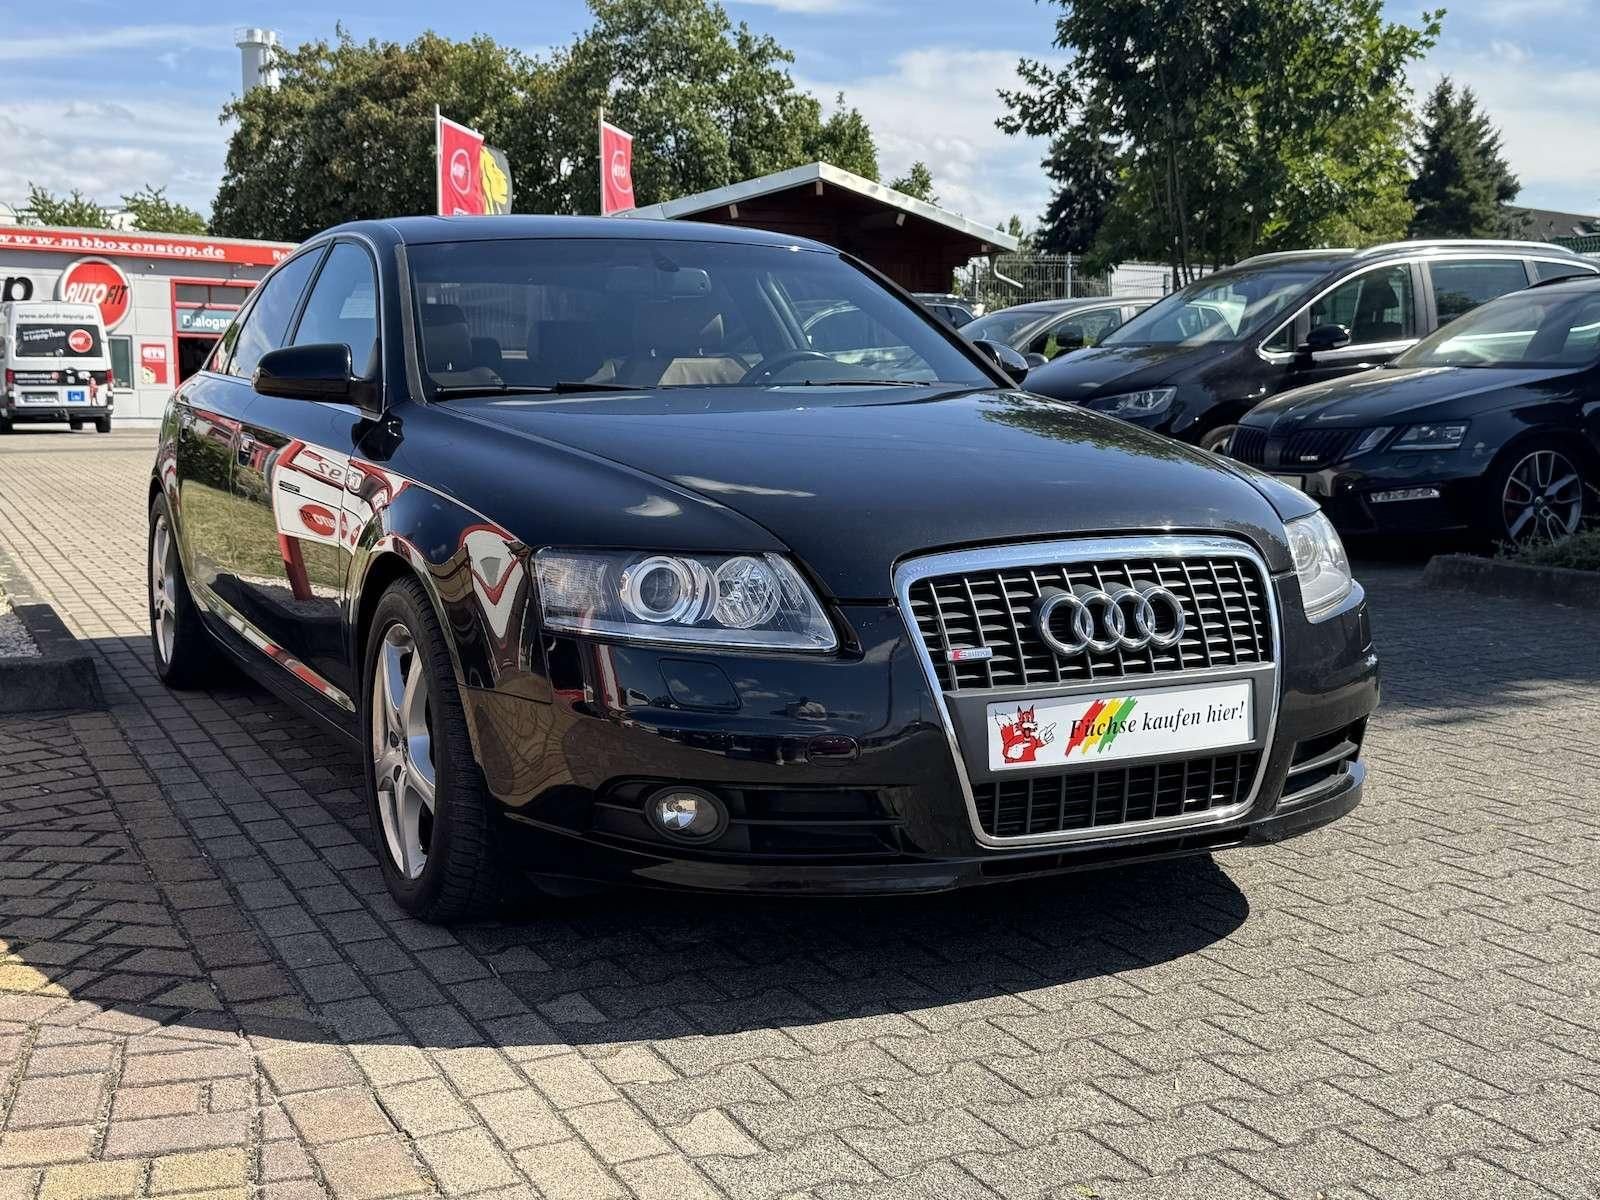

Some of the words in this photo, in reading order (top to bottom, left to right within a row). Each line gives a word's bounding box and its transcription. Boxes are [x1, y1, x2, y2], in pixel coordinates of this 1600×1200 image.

[66, 282, 107, 304] AUTO
[106, 286, 129, 306] FIT
[1069, 716, 1136, 738] Füchse
[1142, 707, 1200, 733] kaufen
[1206, 700, 1244, 724] hier!
